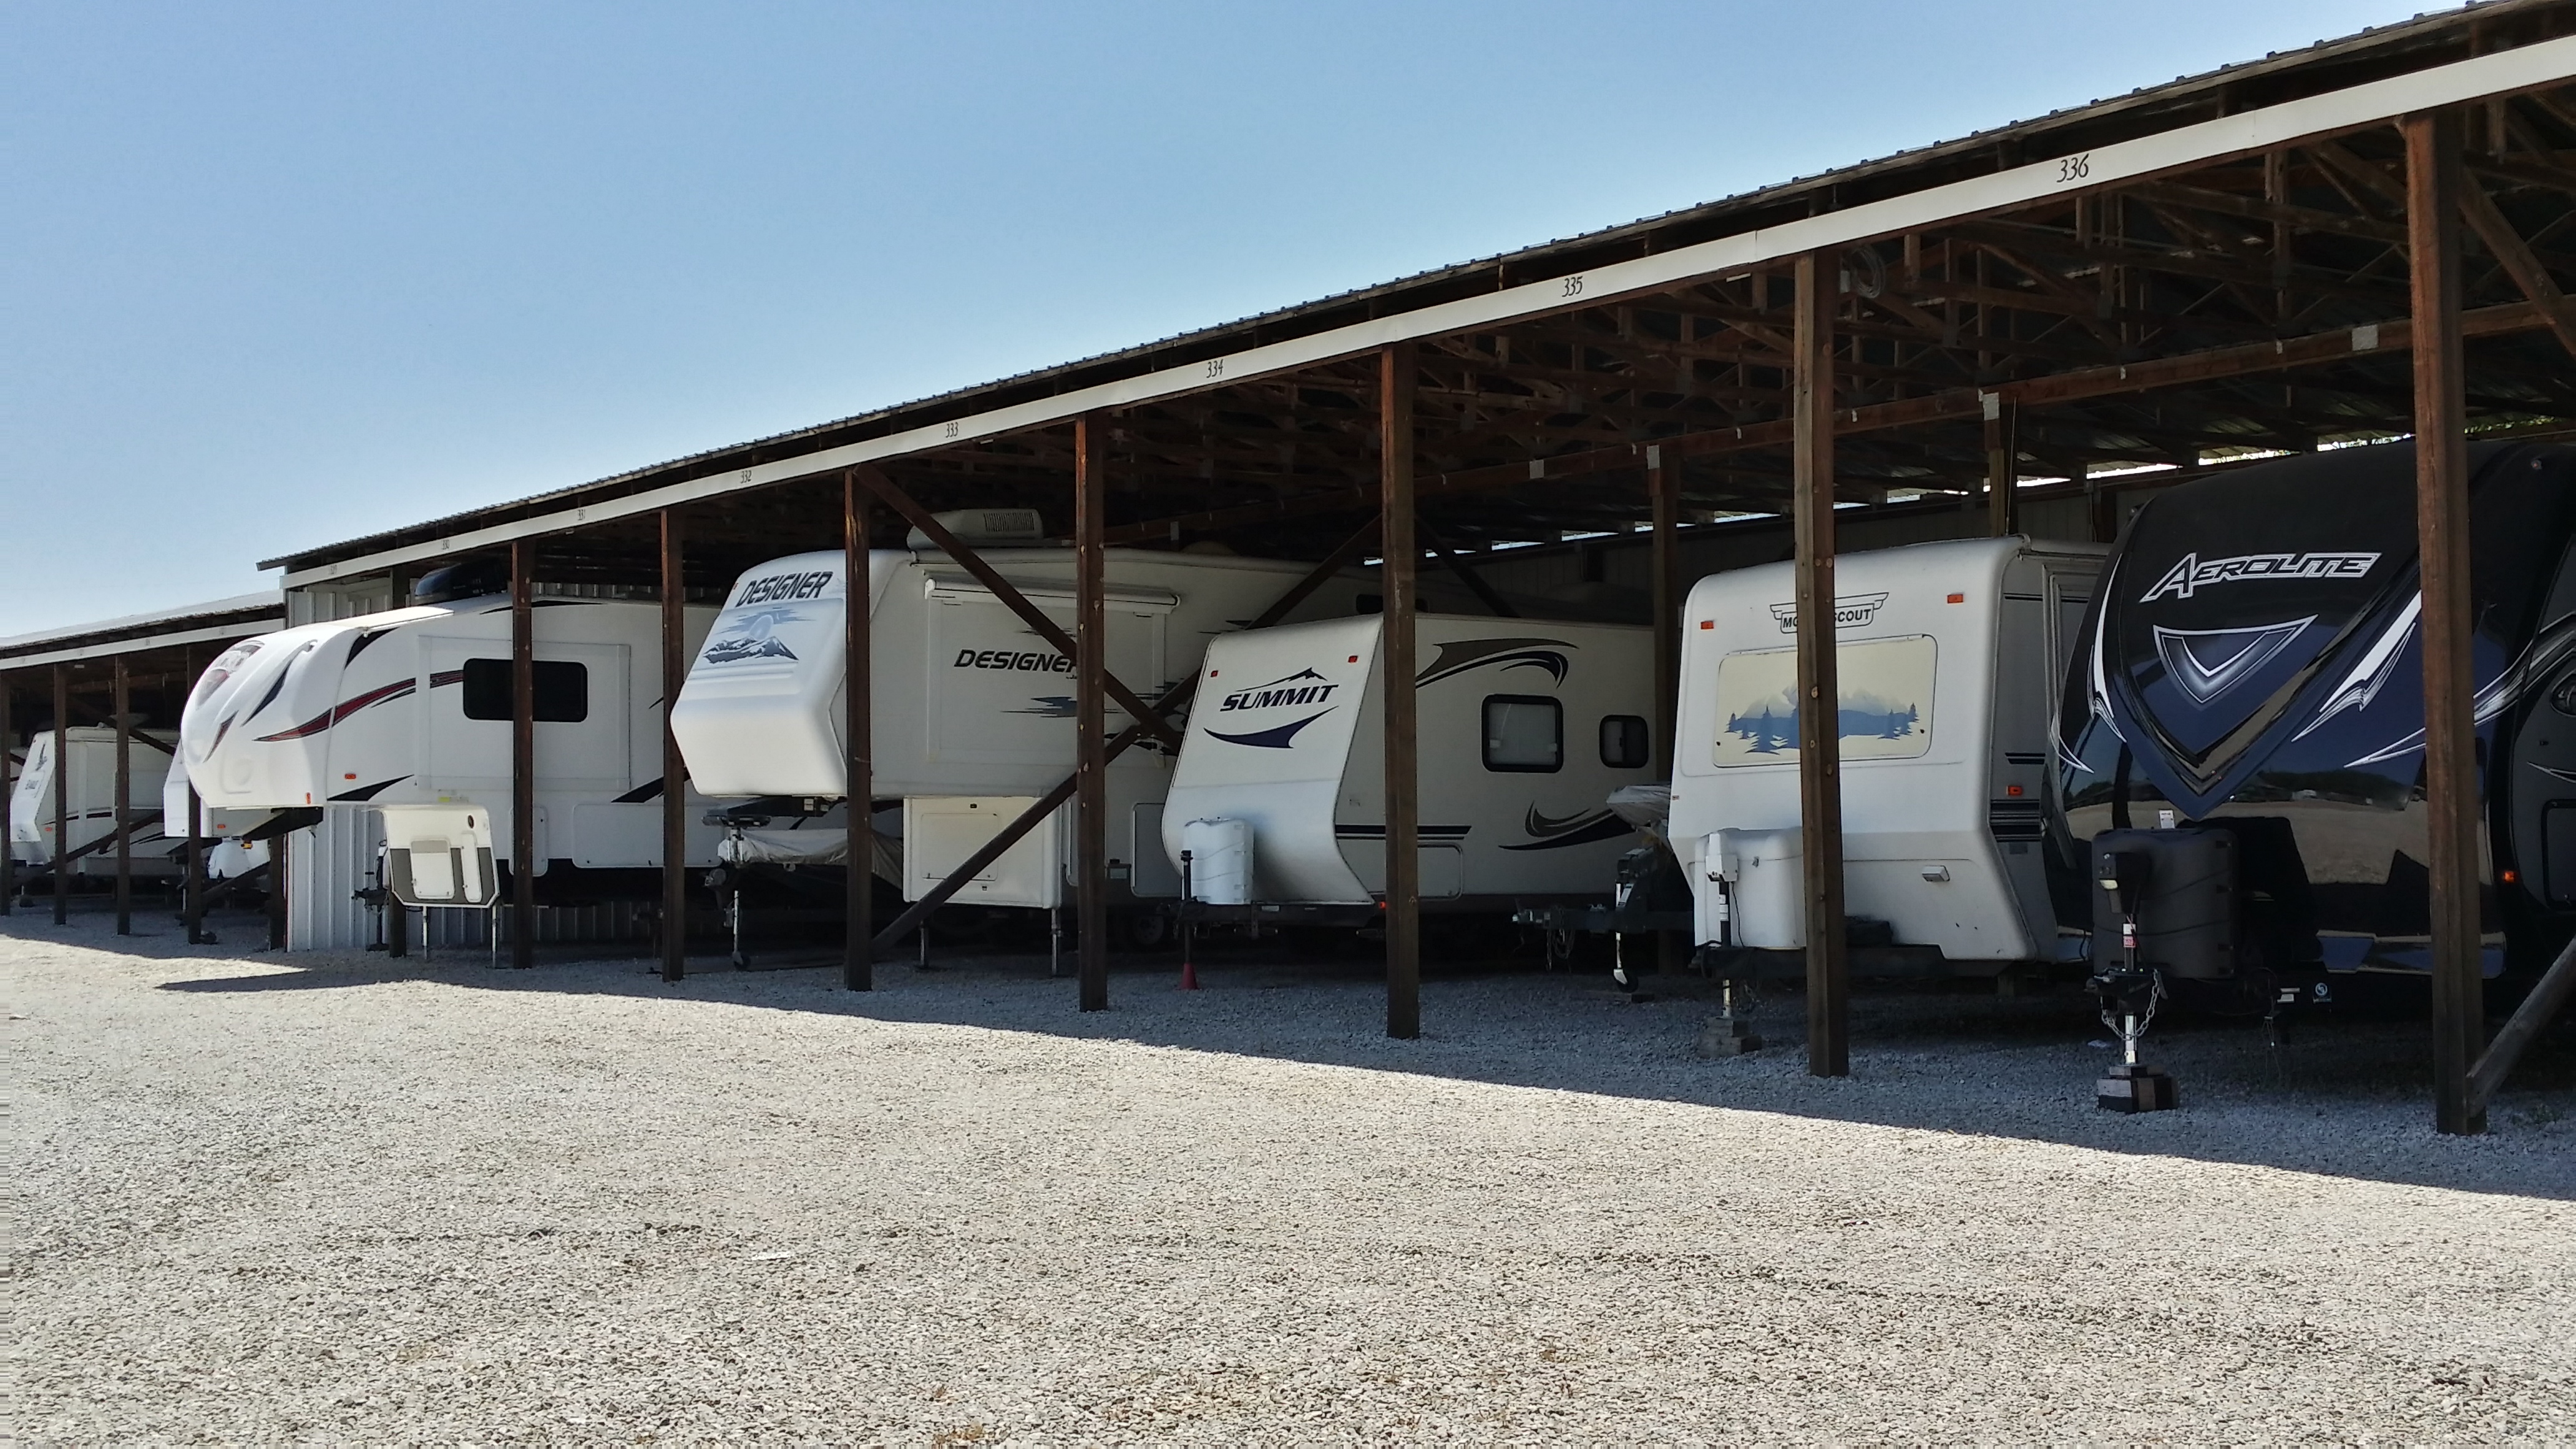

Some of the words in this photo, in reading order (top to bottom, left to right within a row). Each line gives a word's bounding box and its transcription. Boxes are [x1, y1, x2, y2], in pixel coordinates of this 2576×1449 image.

[2056, 153, 2089, 183] 336
[1561, 275, 1583, 298] 335
[1206, 358, 1224, 379] 334
[945, 421, 959, 438] 333
[740, 470, 752, 484] 332
[734, 570, 834, 608] DESIGNER
[2139, 552, 2383, 603] AEROLITE
[1219, 684, 1339, 712] SUMMIT
